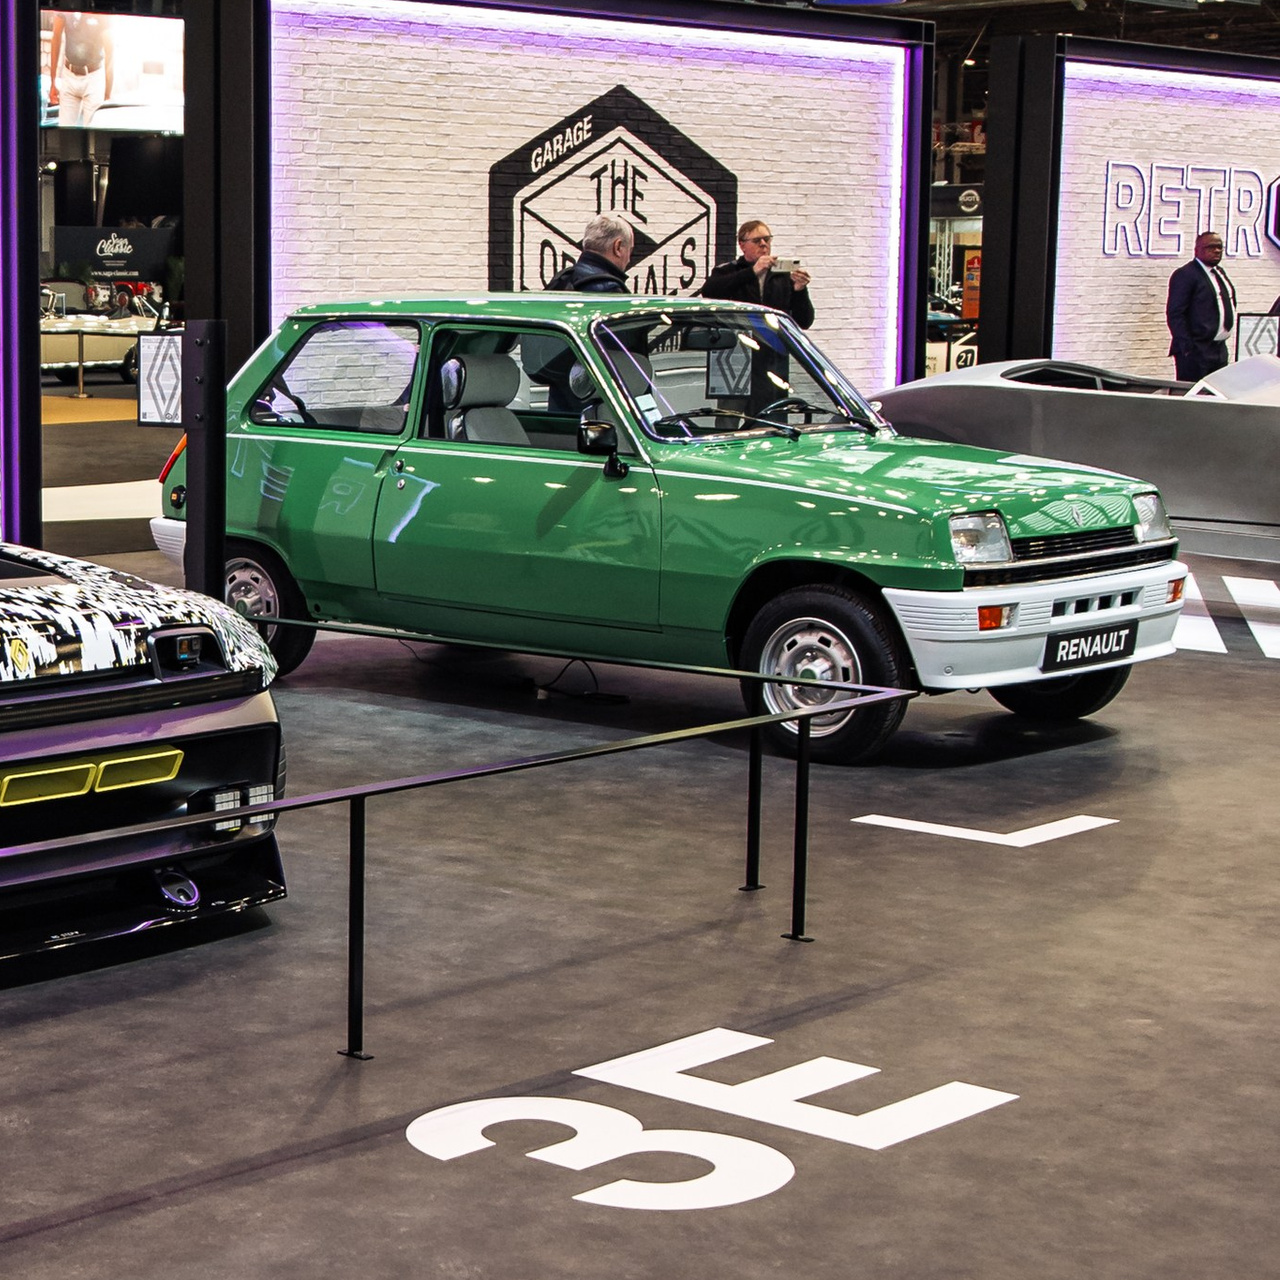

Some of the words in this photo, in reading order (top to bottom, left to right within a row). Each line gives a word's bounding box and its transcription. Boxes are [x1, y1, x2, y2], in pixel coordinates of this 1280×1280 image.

[530, 114, 593, 173] GARAGE
[589, 158, 648, 225] THE
[96, 239, 133, 257] Classic
[957, 352, 972, 366] 21
[1056, 628, 1130, 662] RENAULT
[406, 1027, 1020, 1210] 3E
